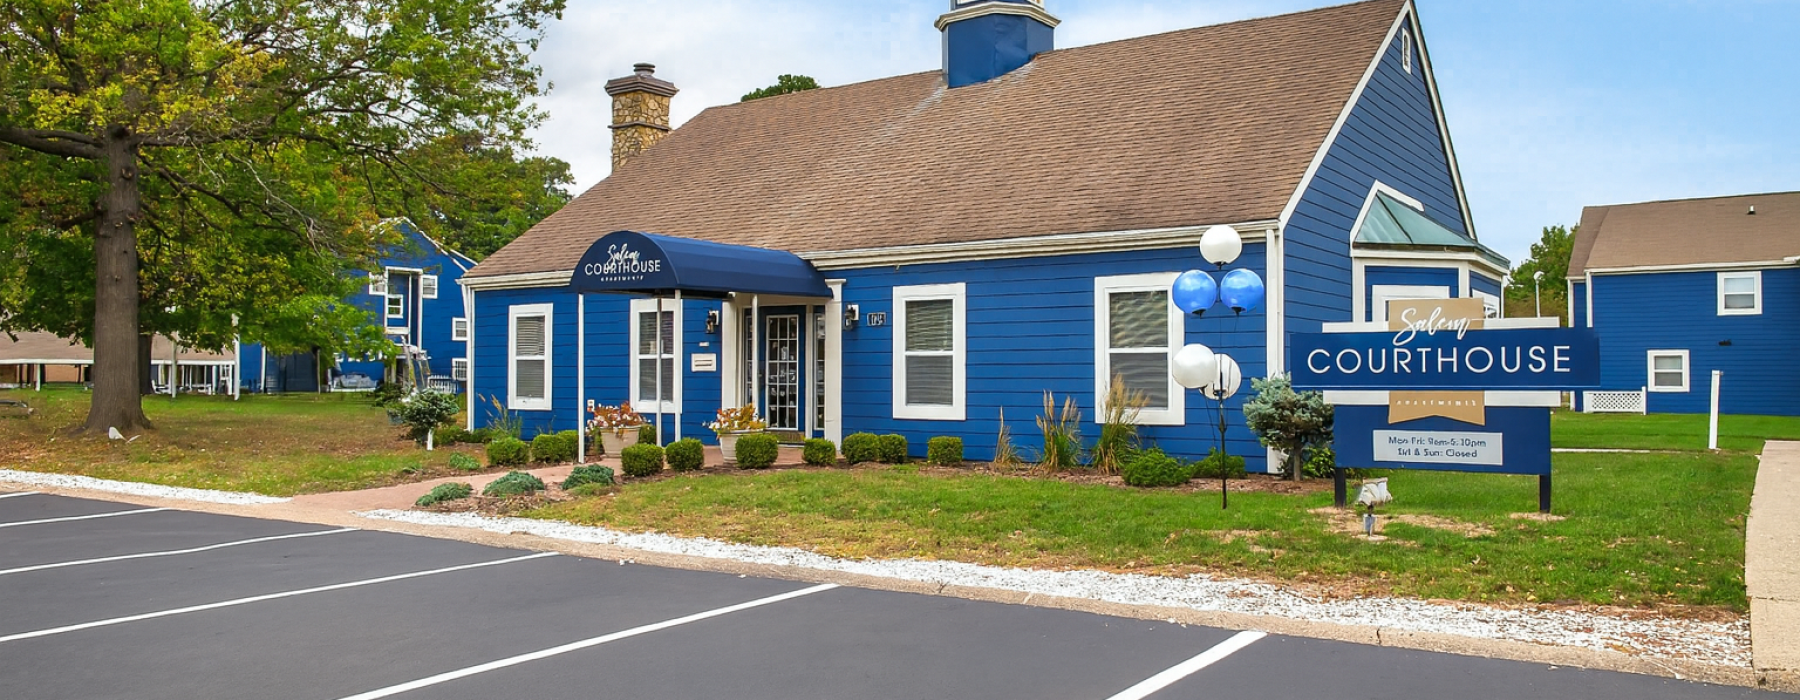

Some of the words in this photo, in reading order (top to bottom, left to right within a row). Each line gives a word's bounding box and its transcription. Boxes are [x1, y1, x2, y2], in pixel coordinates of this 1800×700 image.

[584, 259, 661, 276] COURTHOUSE
[1392, 306, 1471, 346] Salem
[1307, 345, 1571, 374] COURTHOUSE
[1445, 448, 1478, 458] Closed
